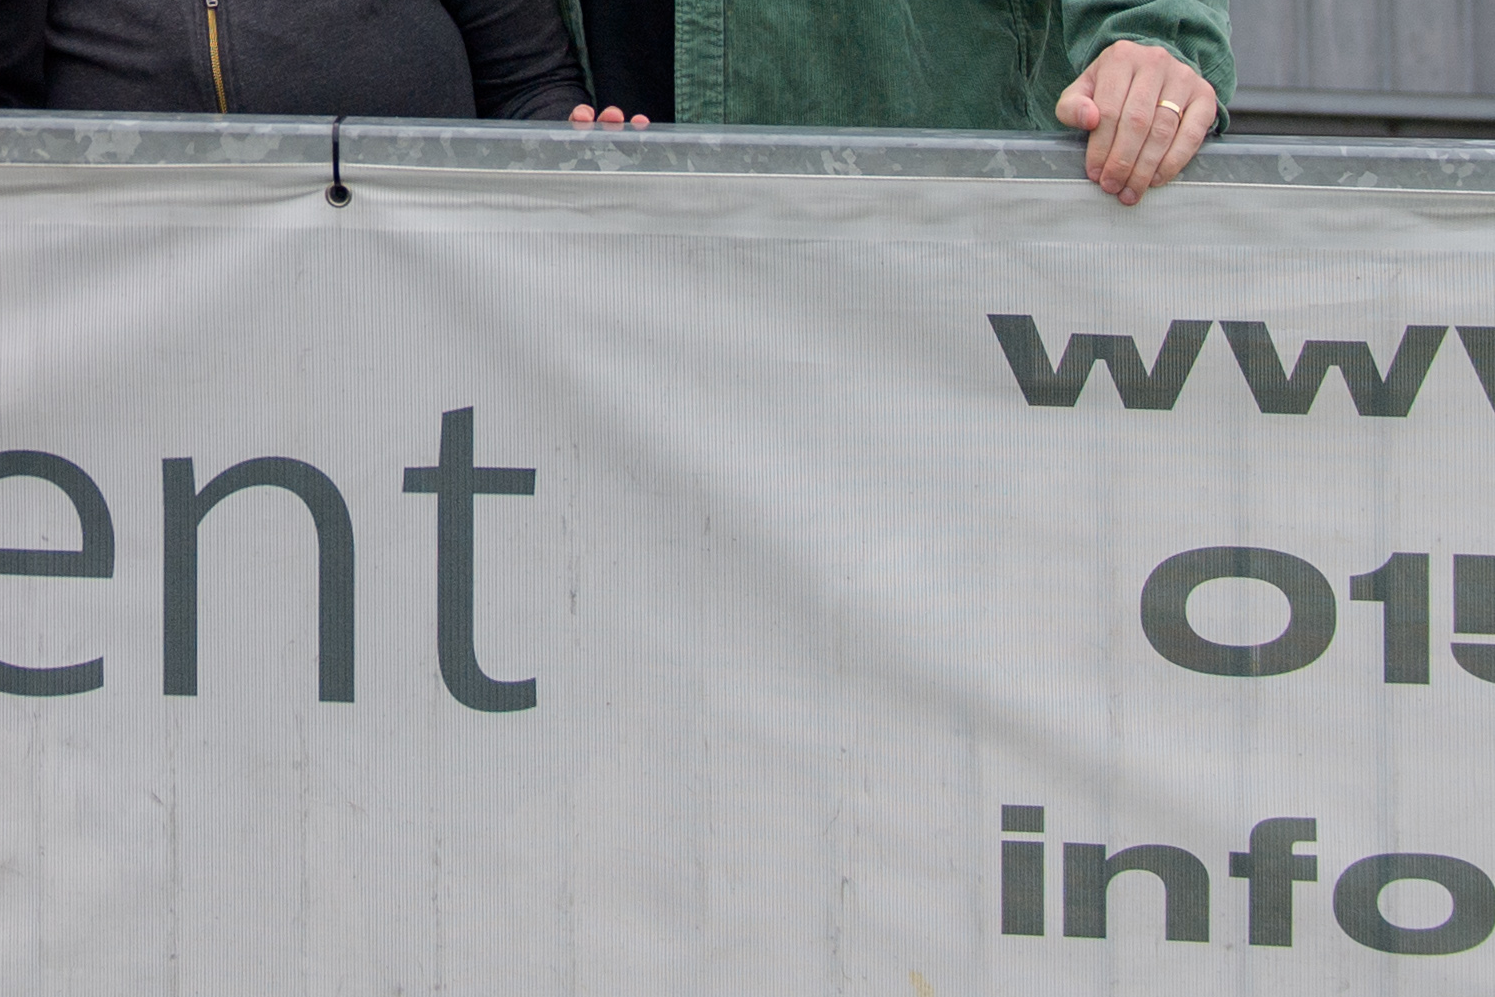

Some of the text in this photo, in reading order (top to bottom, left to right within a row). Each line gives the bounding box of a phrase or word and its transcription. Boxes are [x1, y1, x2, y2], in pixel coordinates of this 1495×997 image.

[987, 313, 1495, 419] ww
[1140, 545, 1495, 686] 01
[1001, 804, 1495, 955] info
